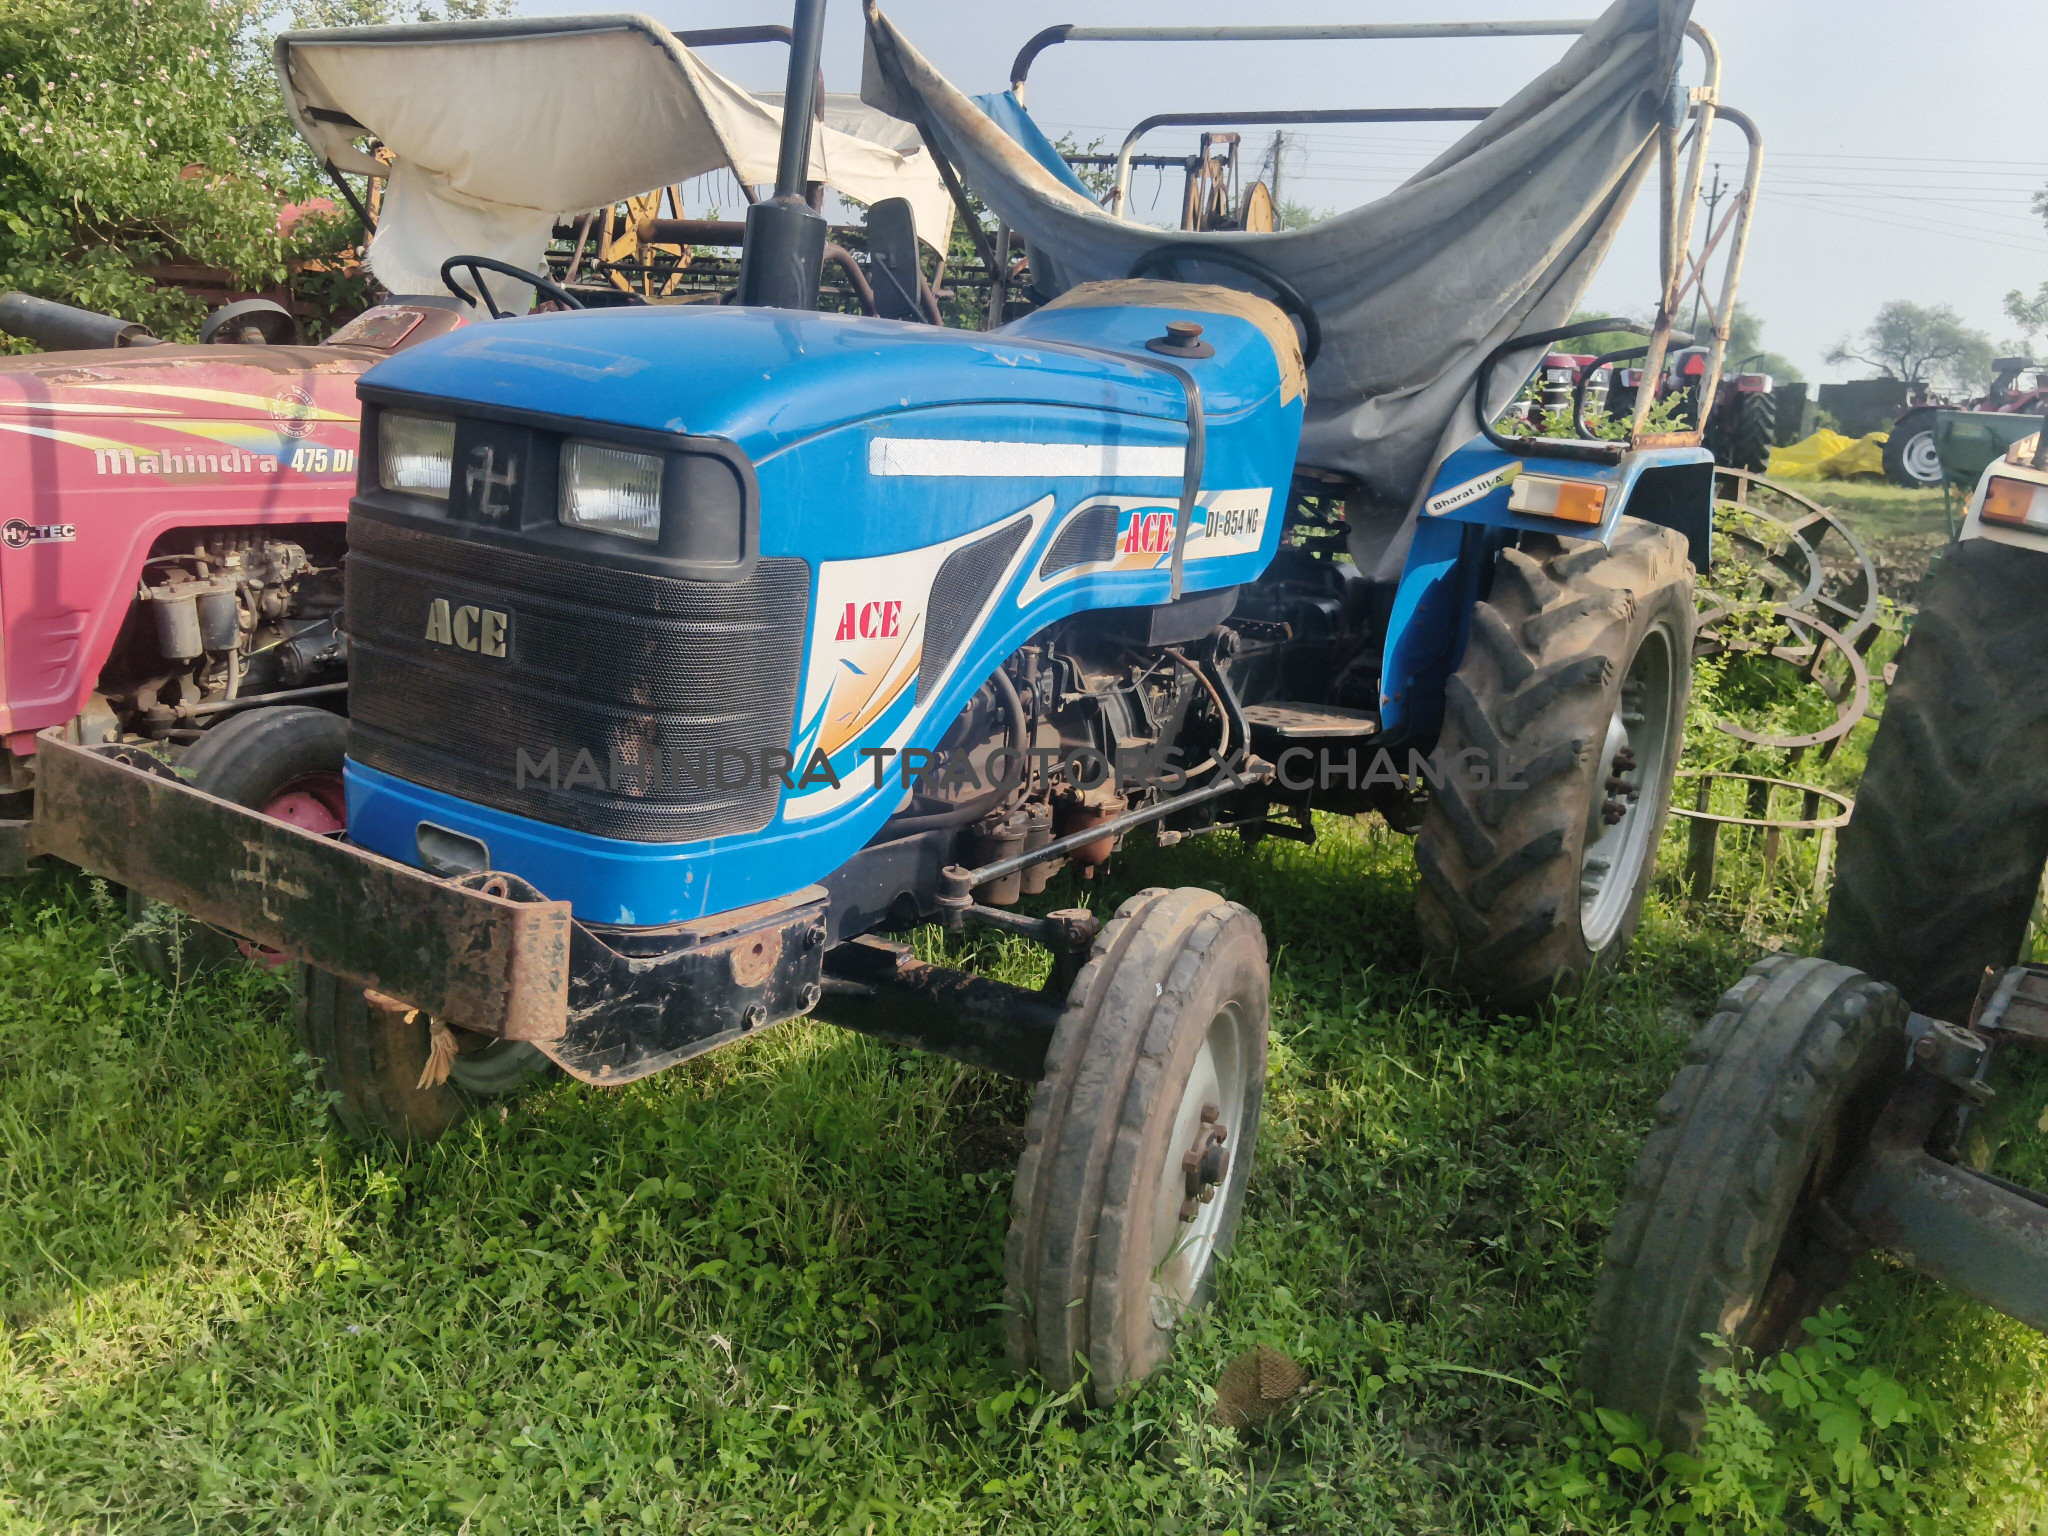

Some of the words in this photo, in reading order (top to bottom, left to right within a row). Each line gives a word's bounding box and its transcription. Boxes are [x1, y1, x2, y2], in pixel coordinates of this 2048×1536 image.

[94, 447, 278, 475] Mahindra
[291, 449, 326, 473] 475
[332, 449, 354, 473] DI
[1433, 488, 1474, 511] Bharat
[1477, 475, 1503, 491] III-A
[3, 525, 75, 542] Hy-TEC
[1122, 511, 1175, 555] ACE
[1204, 509, 1243, 539] DI-854
[1245, 508, 1259, 534] NG
[425, 598, 507, 658] ACE
[835, 600, 902, 641] ACE
